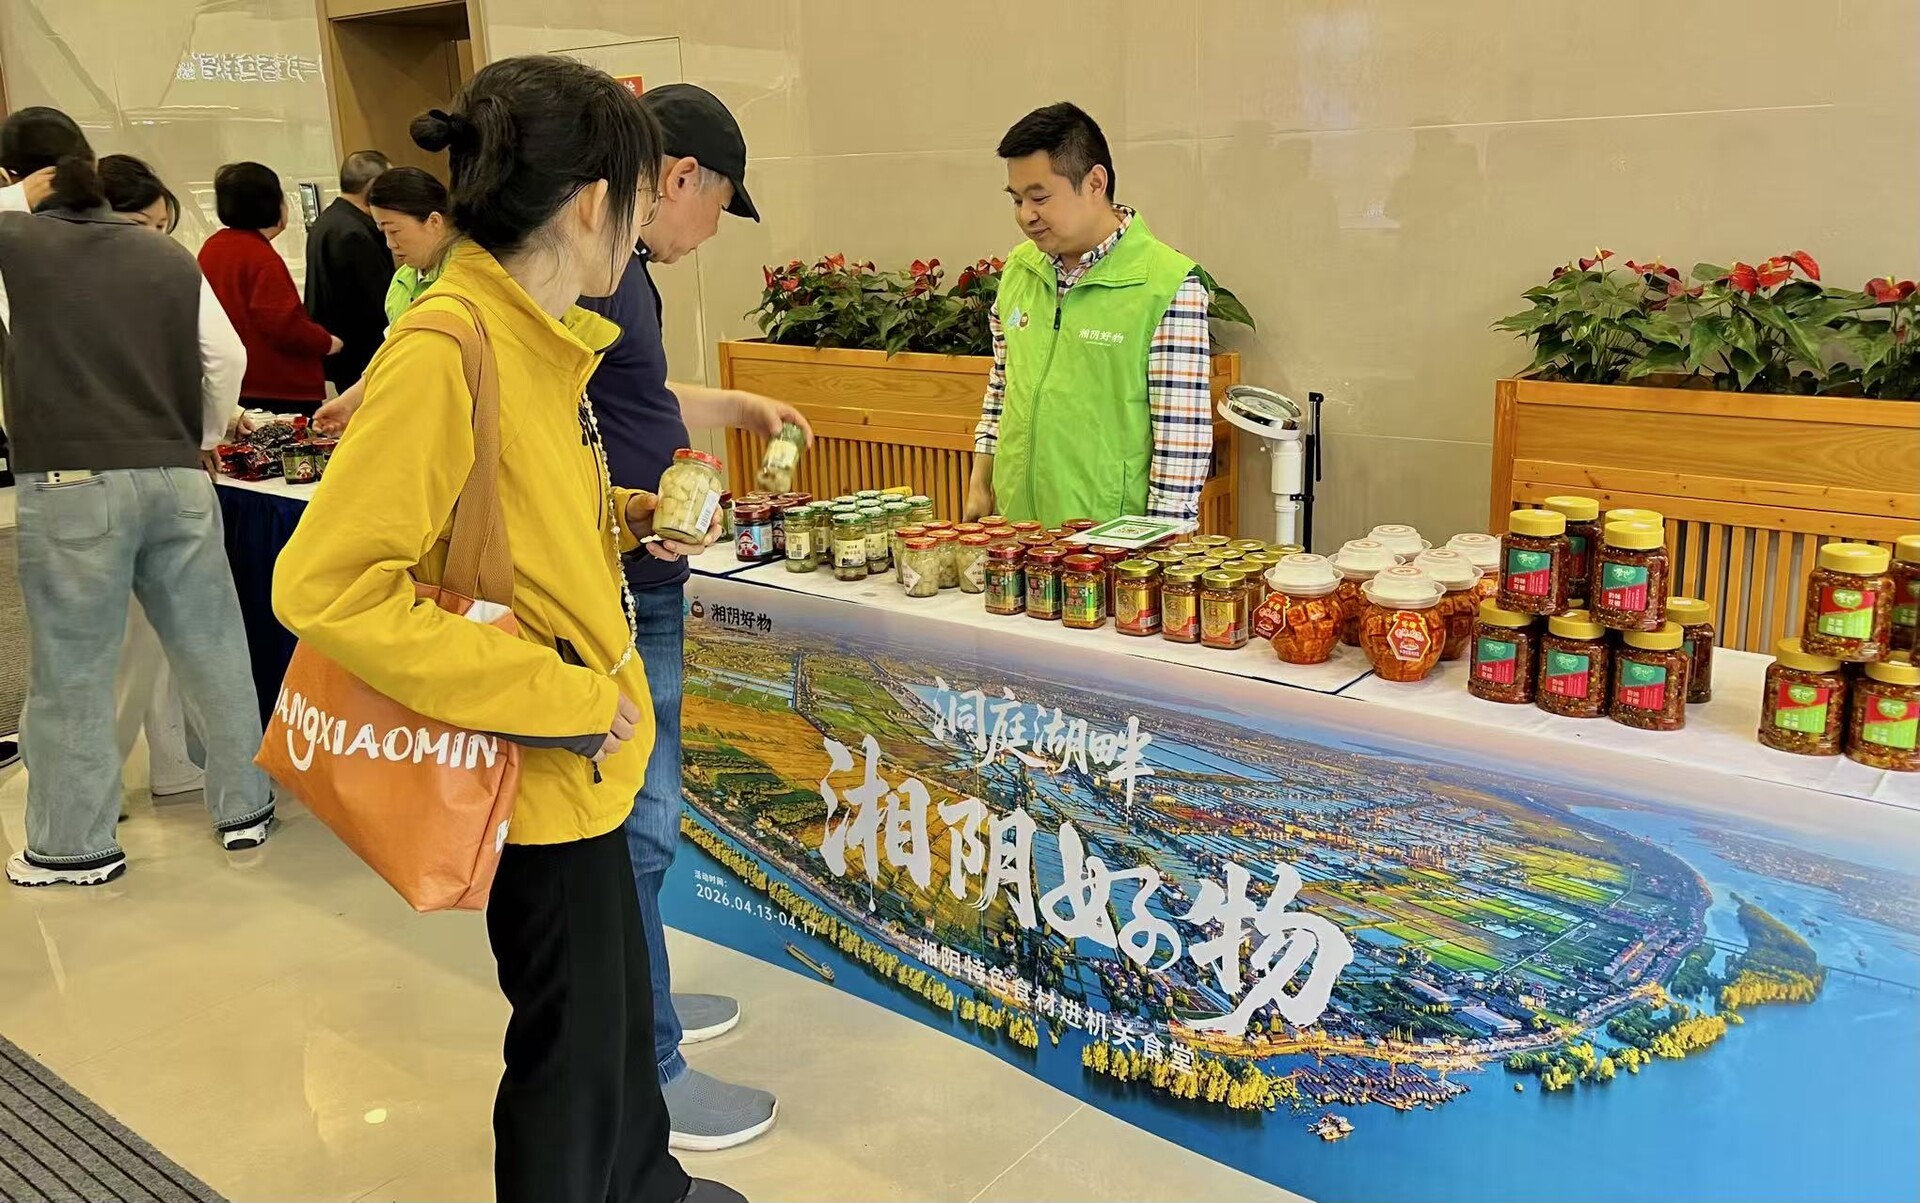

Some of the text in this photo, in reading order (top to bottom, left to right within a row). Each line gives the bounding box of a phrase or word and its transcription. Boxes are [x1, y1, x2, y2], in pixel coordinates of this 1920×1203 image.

[1078, 328, 1124, 344] 湘阴好物
[711, 604, 772, 633] 湘阴好物
[933, 676, 1155, 808] 洞庭湖畔
[695, 883, 818, 937] 2026.04.13-04.17
[820, 734, 1354, 1037] 湘阴好物
[917, 936, 1196, 1076] 湘阴特色食材进机关食堂
